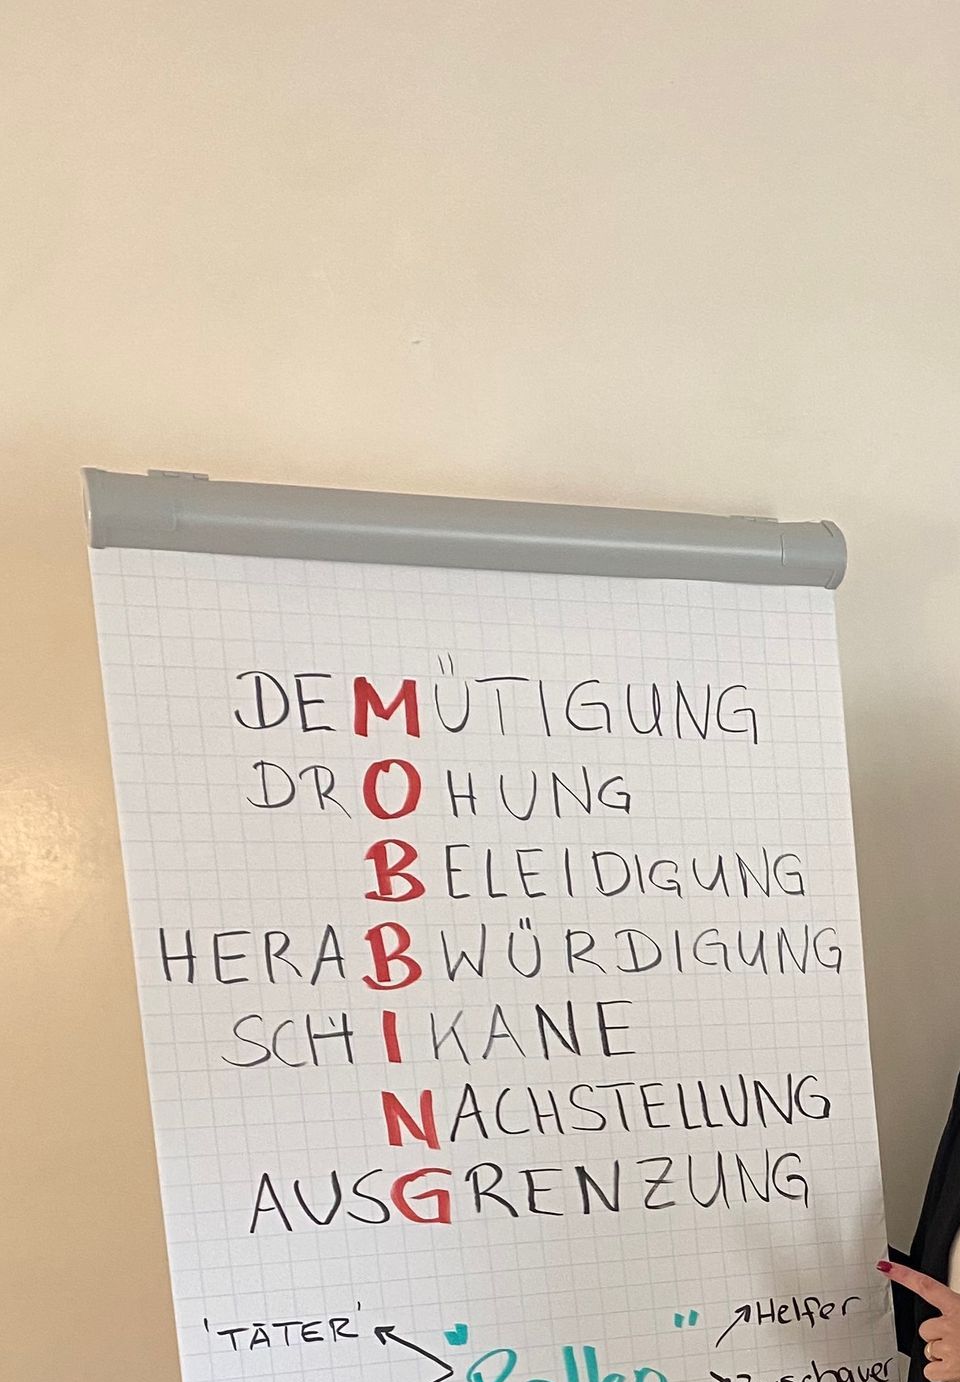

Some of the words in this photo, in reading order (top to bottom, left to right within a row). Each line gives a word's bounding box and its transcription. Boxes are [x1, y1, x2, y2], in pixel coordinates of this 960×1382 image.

[234, 655, 758, 745] DEMÜTIGUNG
[247, 759, 631, 821] DROHUNG
[364, 839, 805, 902] BELEIDIGUNG
[159, 918, 842, 990] HERABWÜRDIGUNG
[221, 1000, 636, 1067] SCHIKANE
[381, 1075, 830, 1149] NACHSTELLUNG
[250, 1152, 808, 1233] AUSGRENZUNG
[756, 1296, 861, 1328] Helfer
